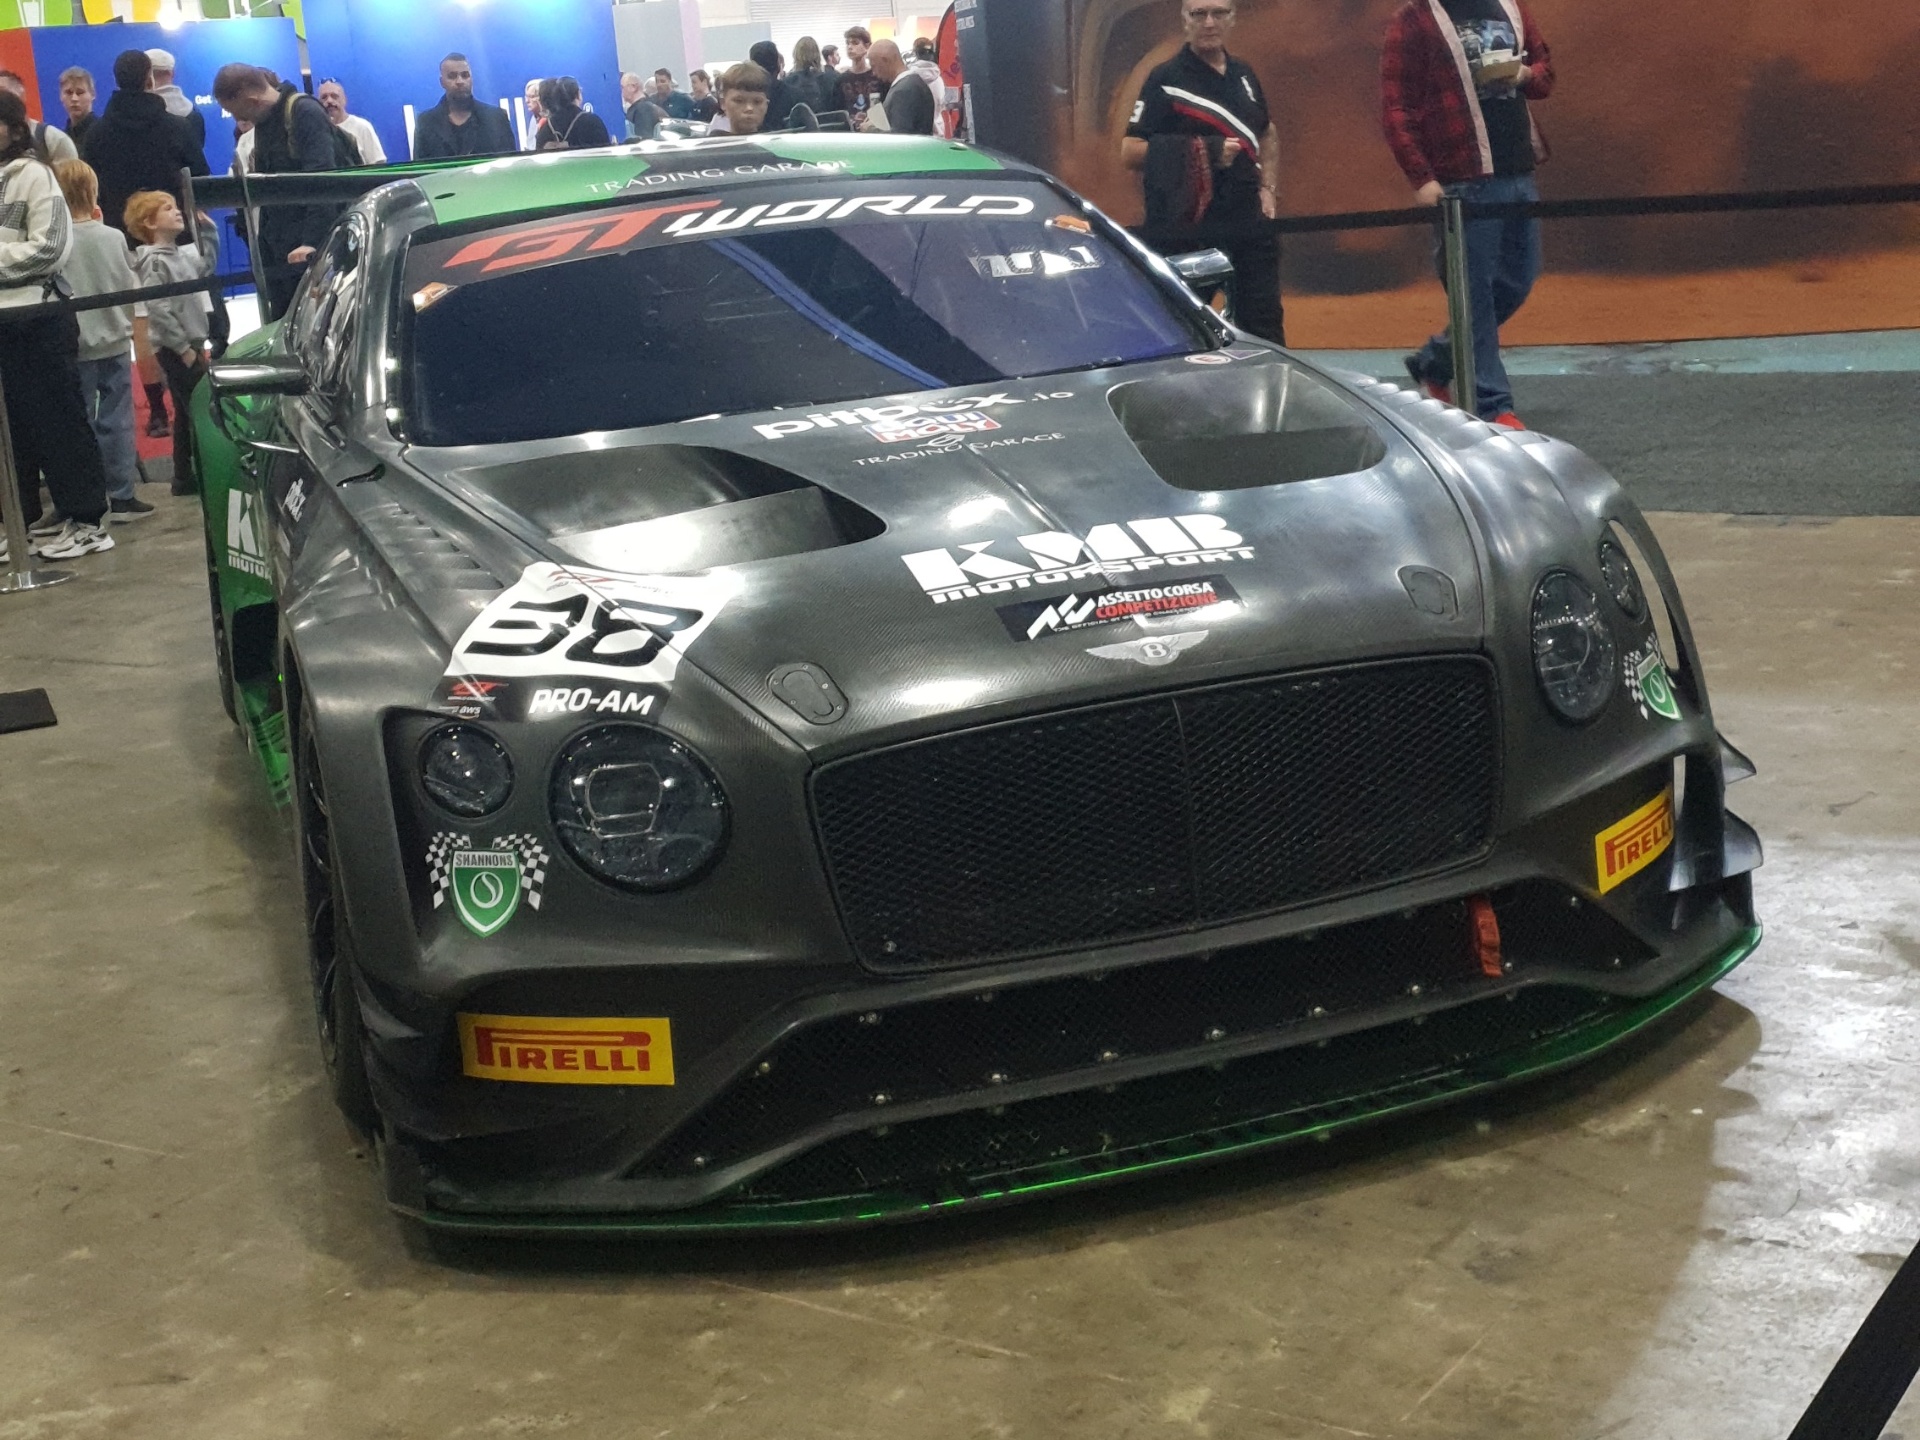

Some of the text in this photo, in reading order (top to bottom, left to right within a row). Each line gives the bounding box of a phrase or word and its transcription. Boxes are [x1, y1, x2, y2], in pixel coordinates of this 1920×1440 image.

[585, 158, 855, 194] TRADING GARAGE
[442, 195, 1036, 271] GT WORLD
[871, 411, 985, 433] LQUI
[881, 419, 990, 441] MOLY
[852, 432, 1067, 467] TRADING GARAGE
[900, 513, 1244, 592] KMB
[1095, 592, 1219, 619] COMPETIZIONE
[1097, 581, 1215, 608] ASSETTO CORSA
[529, 687, 655, 716] PRO-AM
[1604, 798, 1673, 878] PIRELLI
[455, 853, 514, 867] SHANNONS
[475, 1025, 652, 1072] PIRELLI
